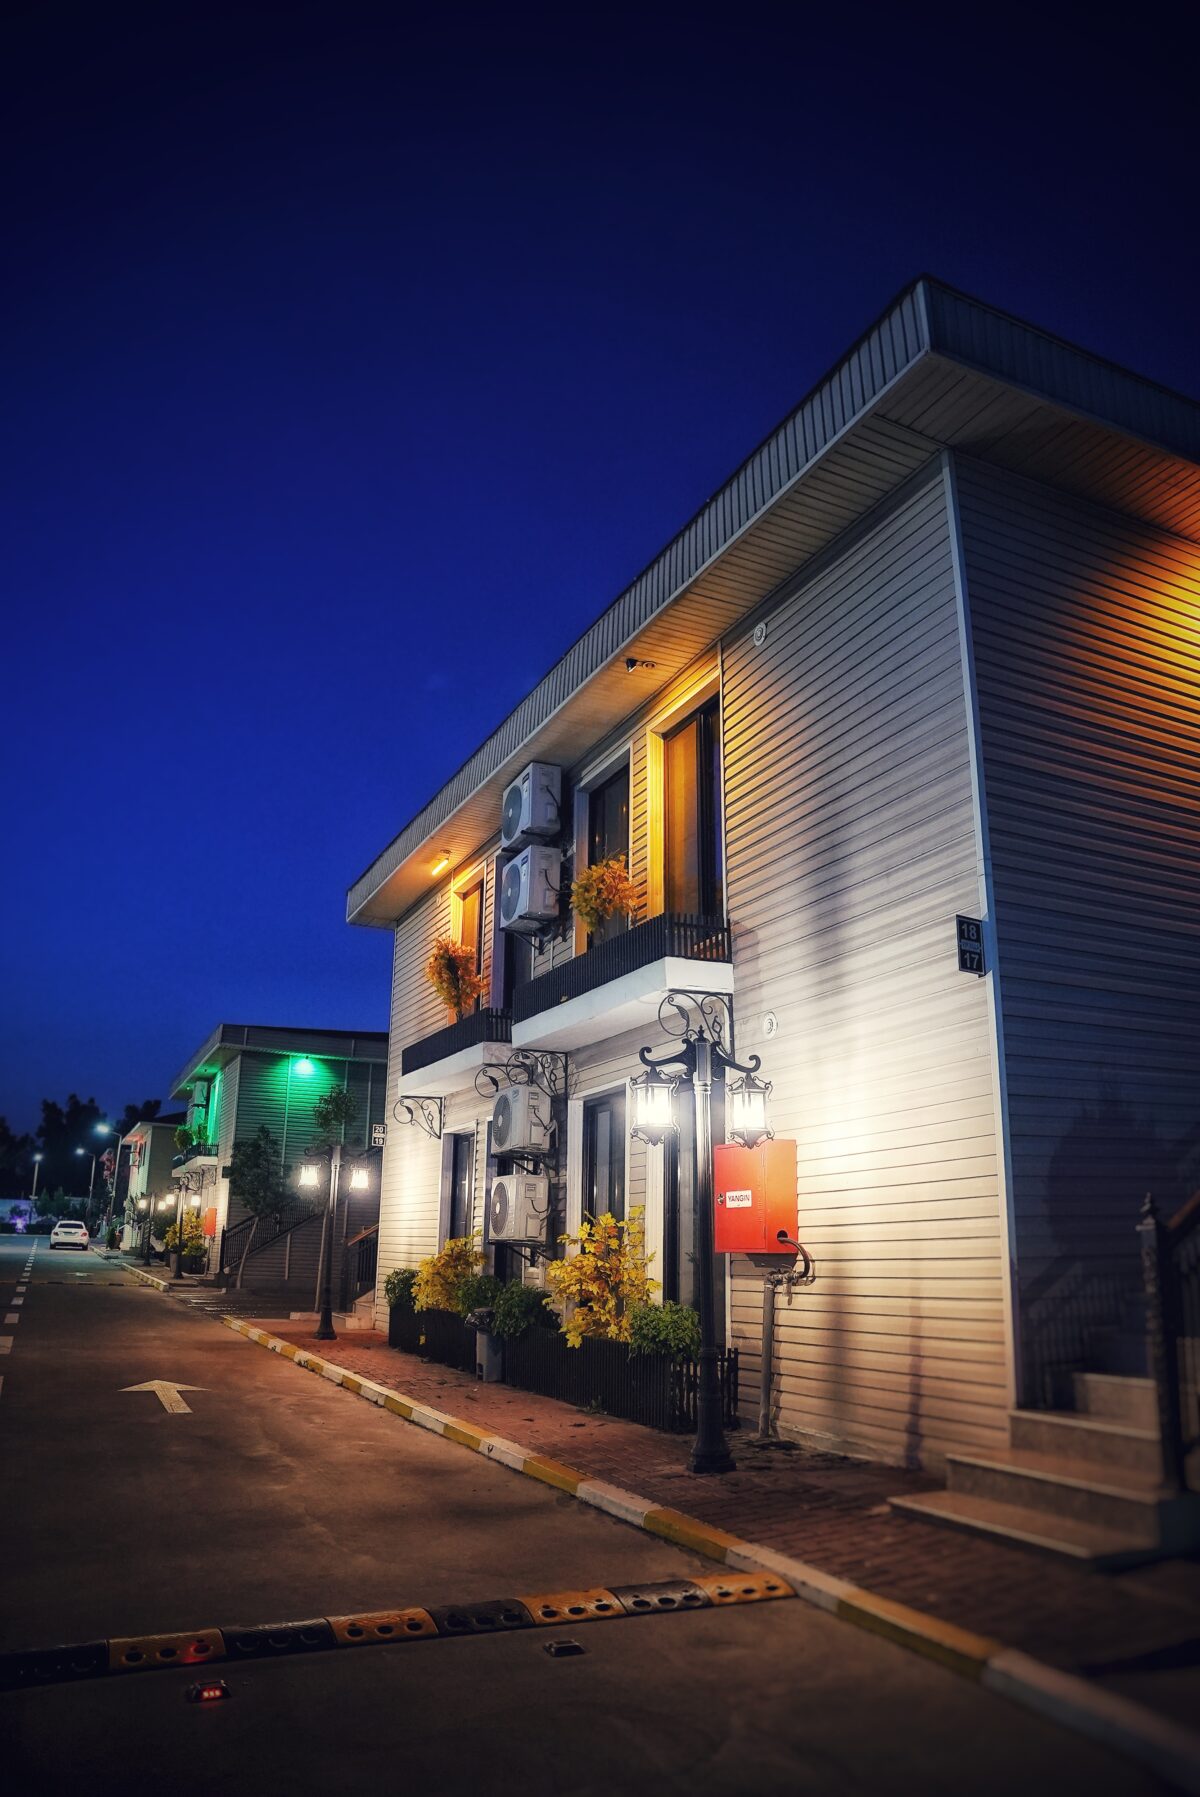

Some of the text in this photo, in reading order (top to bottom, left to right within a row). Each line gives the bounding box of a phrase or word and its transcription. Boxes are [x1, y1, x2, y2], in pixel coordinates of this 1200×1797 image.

[961, 923, 977, 939] 18
[964, 952, 979, 968] 17
[374, 1137, 383, 1145] 19
[728, 1194, 750, 1202] YANGIN
